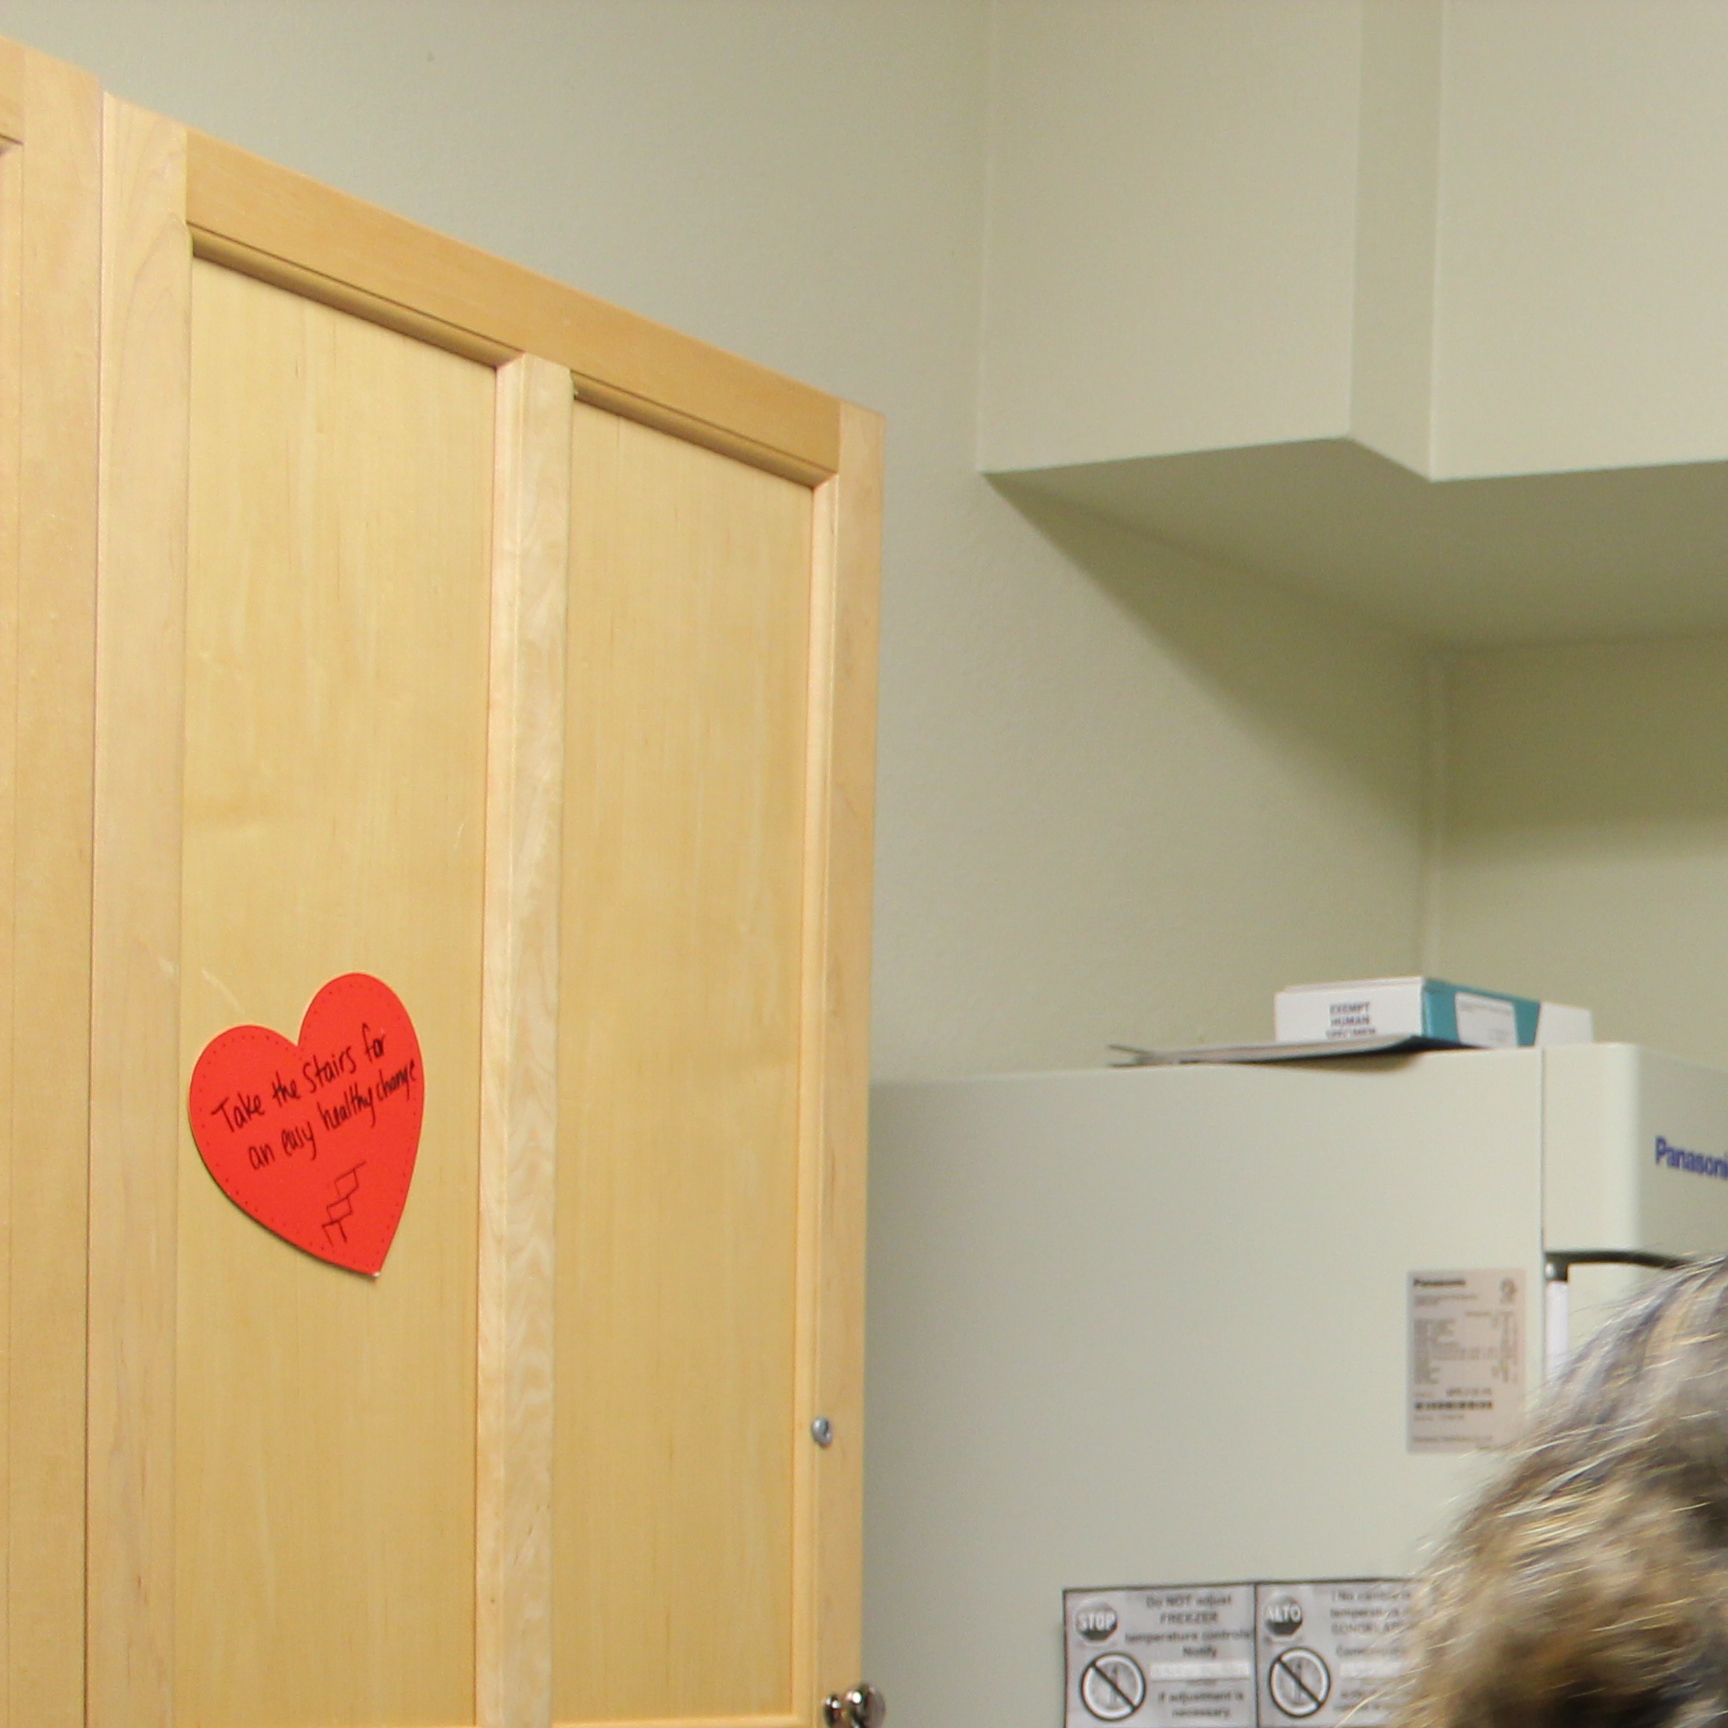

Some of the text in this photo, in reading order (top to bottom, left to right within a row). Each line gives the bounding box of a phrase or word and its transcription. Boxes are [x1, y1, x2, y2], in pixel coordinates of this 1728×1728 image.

[1329, 1001, 1370, 1015] EXEMPT
[1330, 1014, 1370, 1027] HUMAN
[211, 1092, 265, 1133] Take
[272, 1071, 301, 1107] the
[362, 1022, 387, 1063] for
[249, 1059, 416, 1170] an easy healthy change
[1166, 1594, 1191, 1606] NOT
[1196, 1593, 1232, 1607] adjust
[1077, 1610, 1117, 1631] STOP
[1160, 1611, 1218, 1624] FREEZER
[1266, 1605, 1302, 1622] ALTO
[1125, 1631, 1198, 1644] temperature
